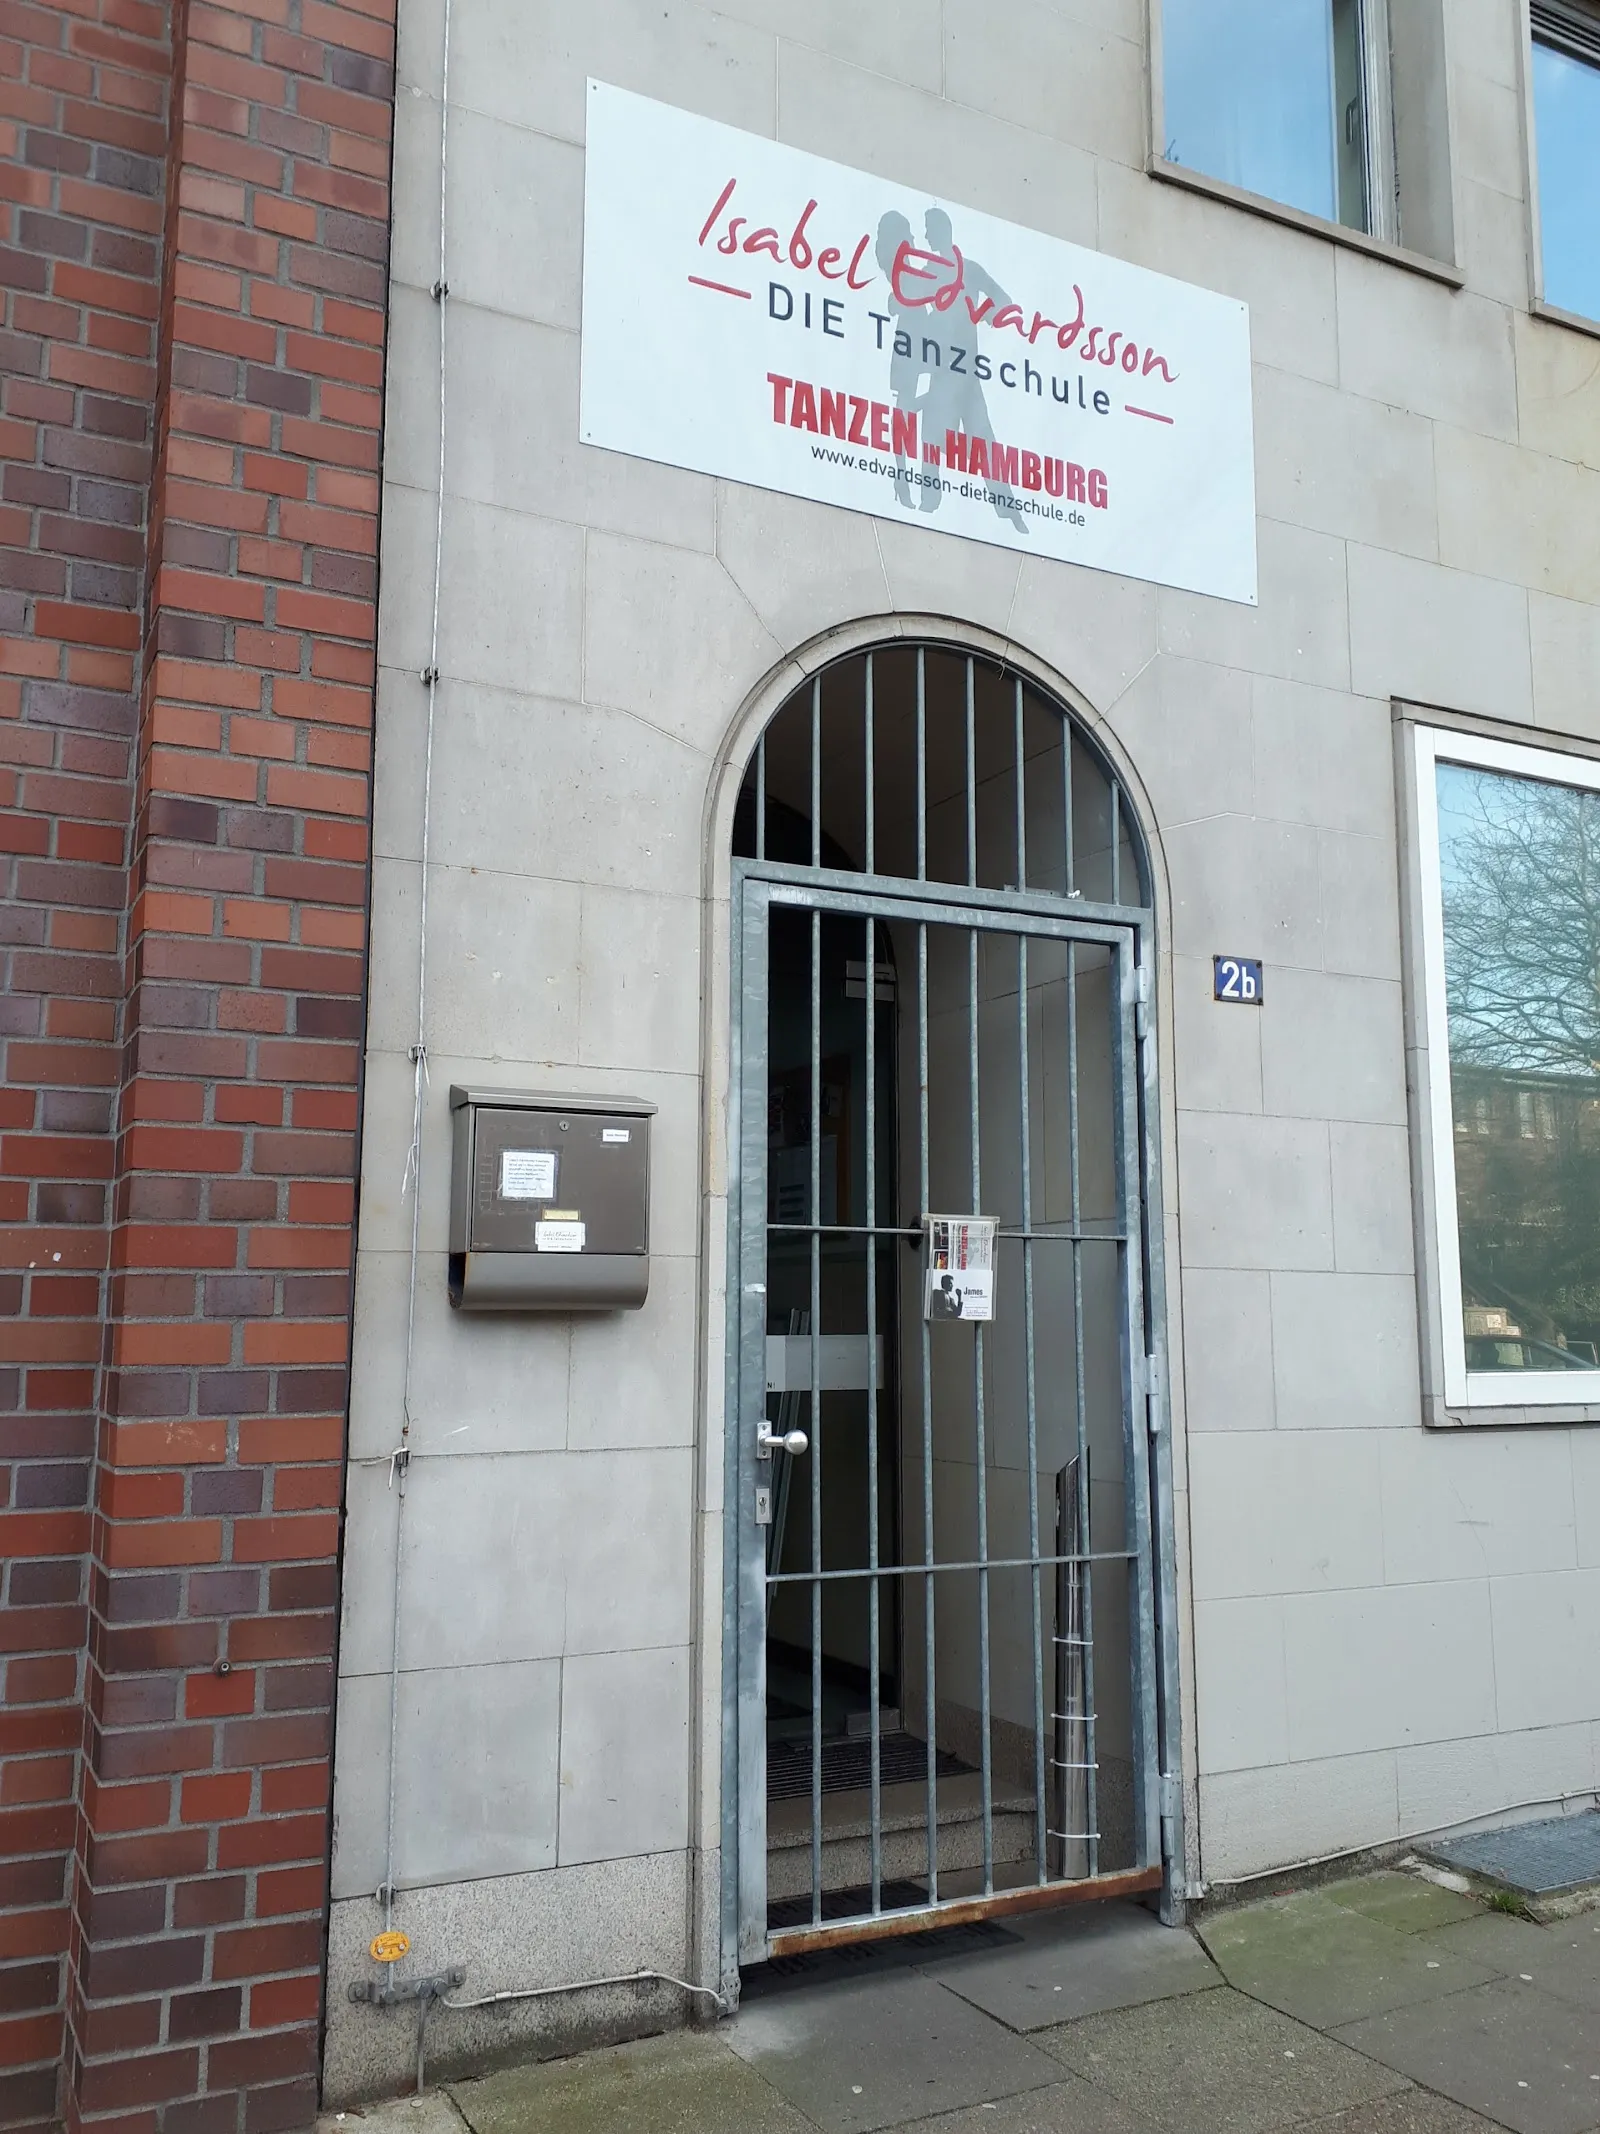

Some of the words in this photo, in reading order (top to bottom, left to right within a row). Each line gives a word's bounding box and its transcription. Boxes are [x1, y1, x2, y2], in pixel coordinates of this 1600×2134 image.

[698, 177, 878, 291] Isabel
[890, 239, 1180, 384] Edvardsson
[768, 282, 845, 339] DIE
[867, 311, 1111, 416] Tanzschule
[766, 372, 918, 460] TANZEN
[923, 442, 941, 467] IN
[945, 428, 1109, 510] HAMBURG
[811, 445, 1086, 526] www.edvardsson-dietanzschule.de
[1221, 960, 1256, 998] 2b
[963, 1286, 983, 1295] James
